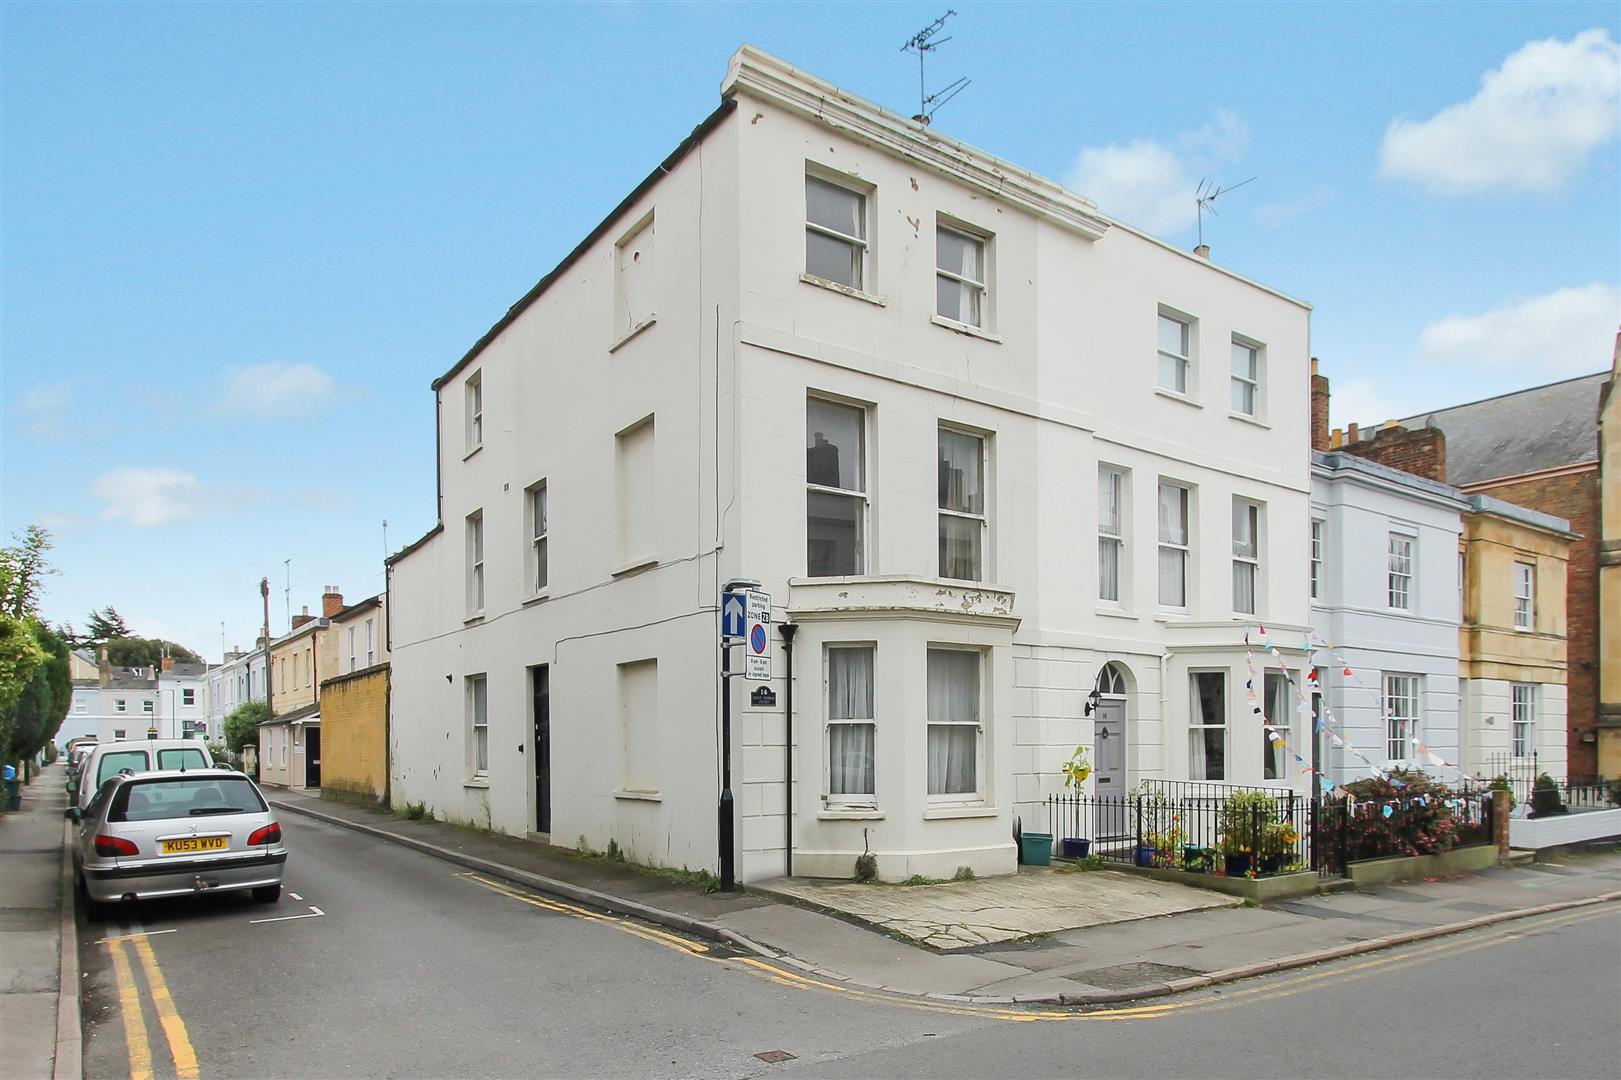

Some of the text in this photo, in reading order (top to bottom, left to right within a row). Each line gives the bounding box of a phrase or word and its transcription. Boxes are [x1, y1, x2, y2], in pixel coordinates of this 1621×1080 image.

[748, 611, 761, 620] ZONE
[167, 839, 222, 851] KU53 WVD
